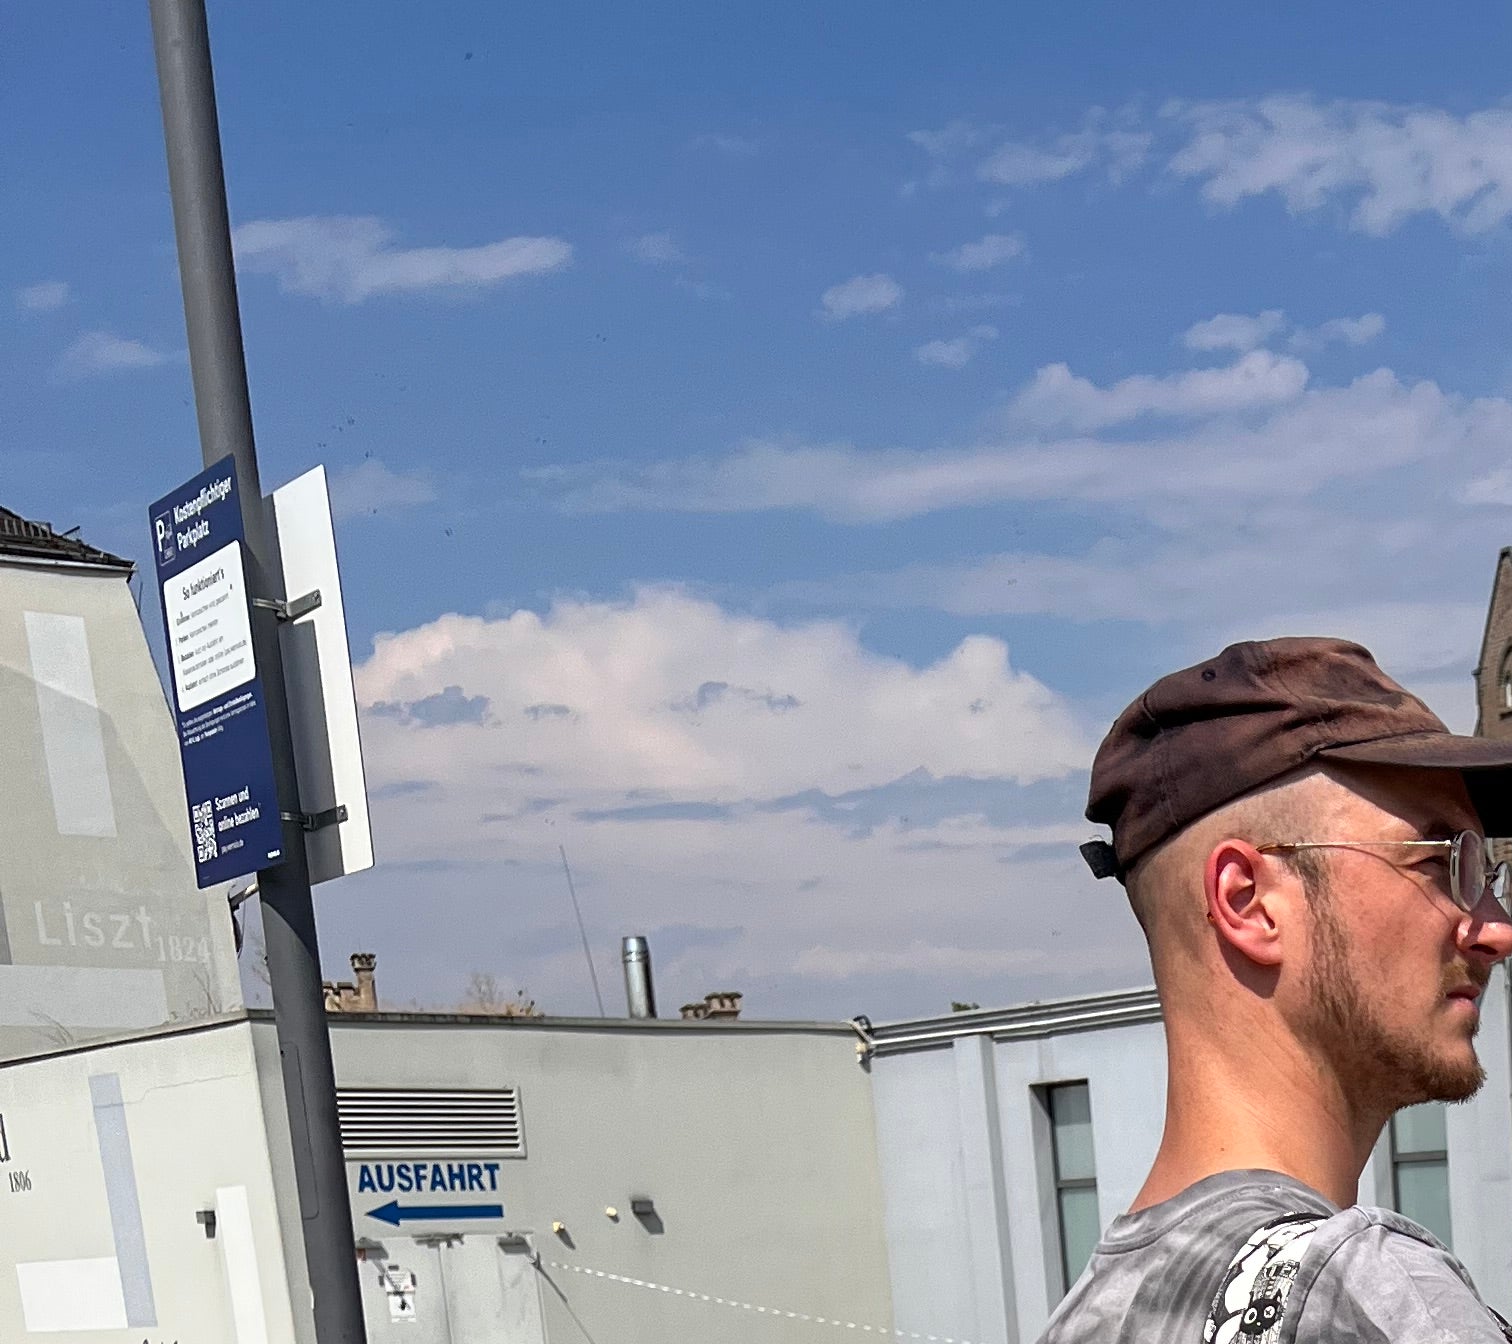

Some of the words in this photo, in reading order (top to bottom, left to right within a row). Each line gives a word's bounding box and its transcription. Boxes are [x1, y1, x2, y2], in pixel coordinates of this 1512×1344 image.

[155, 519, 165, 553] P
[176, 519, 210, 552] Parkplatz
[35, 899, 151, 949] Liszt
[8, 1169, 32, 1193] 1806
[358, 1162, 501, 1194] AUSFAHRT
